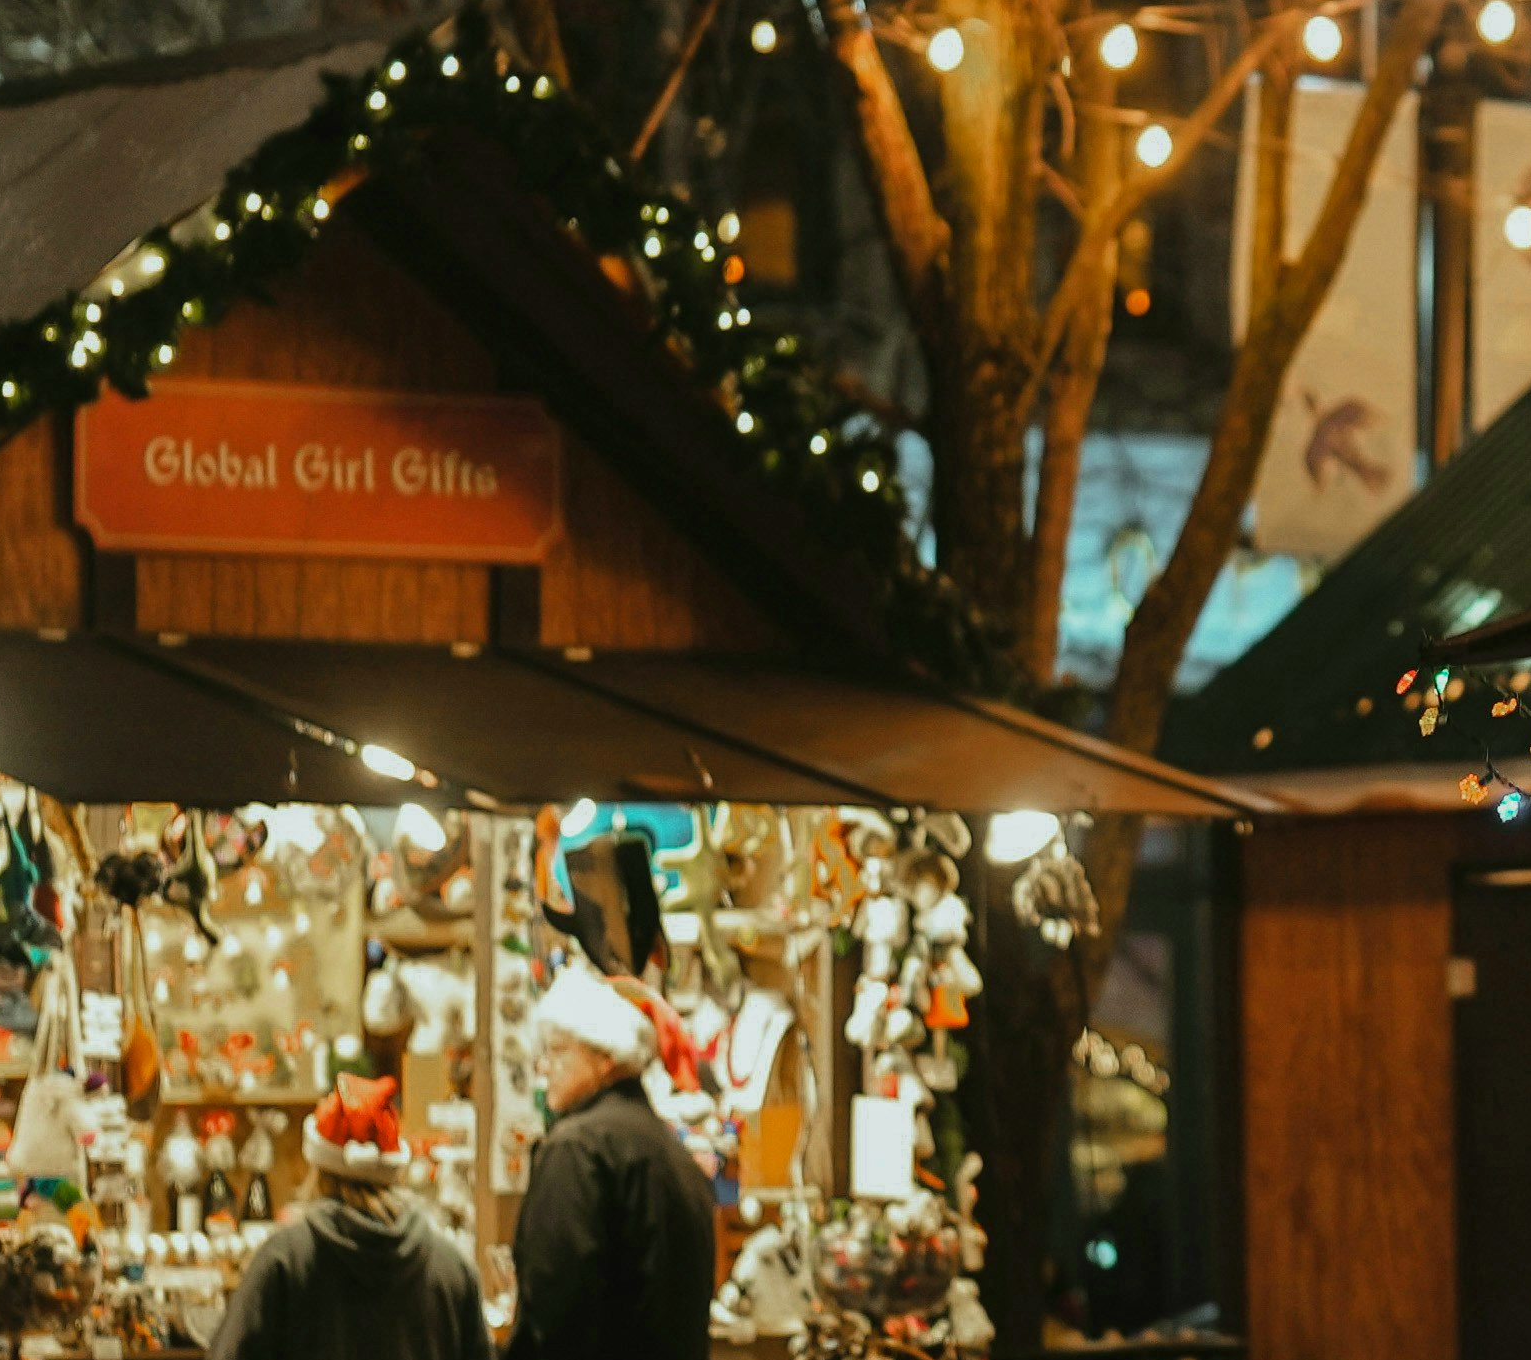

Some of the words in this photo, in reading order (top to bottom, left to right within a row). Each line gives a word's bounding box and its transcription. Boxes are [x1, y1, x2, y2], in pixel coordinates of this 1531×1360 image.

[143, 436, 277, 491] Global
[292, 441, 375, 495] Girl
[390, 445, 499, 497] Gifts
